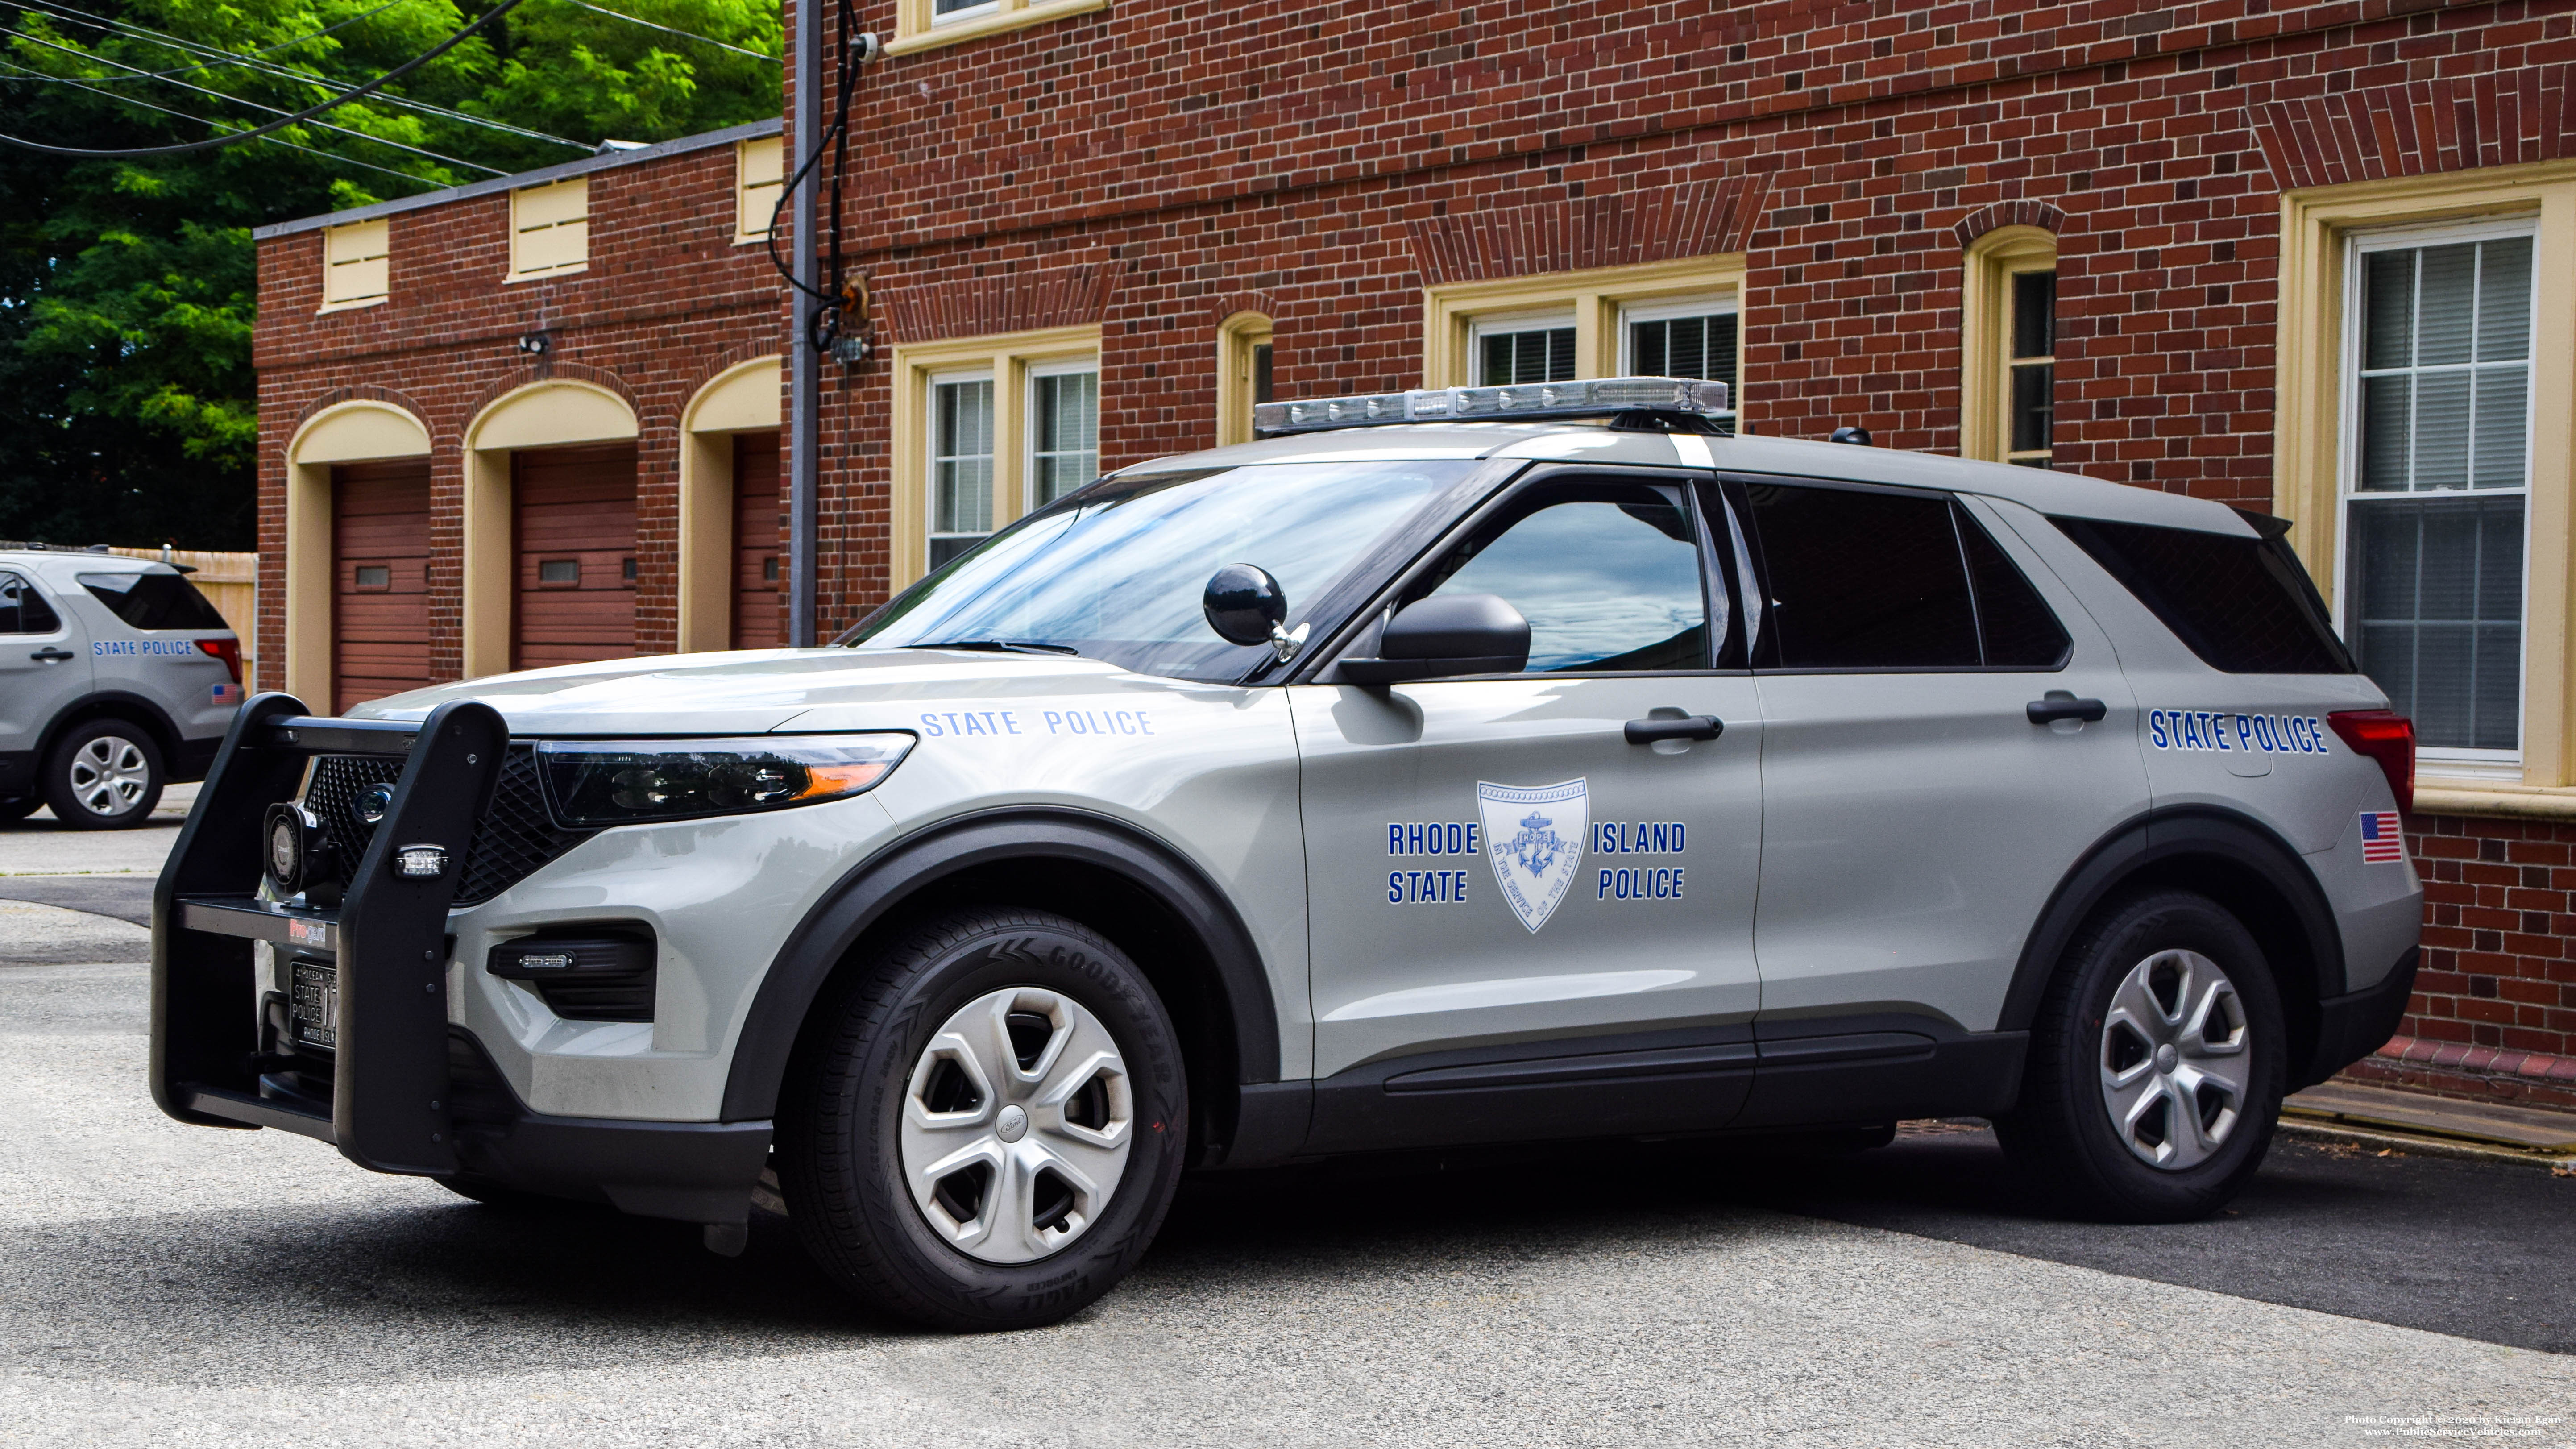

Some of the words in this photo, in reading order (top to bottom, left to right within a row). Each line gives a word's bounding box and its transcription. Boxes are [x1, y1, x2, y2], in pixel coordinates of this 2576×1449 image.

[94, 640, 136, 655] STATE
[143, 641, 192, 655] POLICE
[920, 711, 1022, 737] STATE
[1043, 710, 1155, 735] POLICE
[2149, 708, 2232, 752] STATE
[2236, 713, 2329, 755] POLICE
[1387, 822, 1479, 856] RHODE
[1593, 822, 1686, 855] ISLAND
[1523, 833, 1548, 841] HOPE
[1388, 870, 1468, 904] STATE
[1597, 868, 1684, 901] POLICE
[1493, 842, 1503, 855] IN
[1498, 857, 1511, 880] THE
[1507, 879, 1534, 918] SERVICE
[1537, 900, 1548, 916] OF
[1547, 878, 1564, 899] THE
[1562, 841, 1578, 876] STATE
[305, 970, 323, 981] OCEAN
[328, 973, 336, 983] STA
[295, 985, 319, 1003] STATE
[292, 1004, 321, 1023] POLICE
[1049, 945, 1171, 1084] GOODYEAR
[304, 1027, 320, 1040] RHODE
[322, 1031, 336, 1043] ISLA
[1006, 1117, 1021, 1131] Ford
[1027, 1268, 1077, 1292] ENFORCER
[1018, 1275, 1089, 1311] EAGLE
